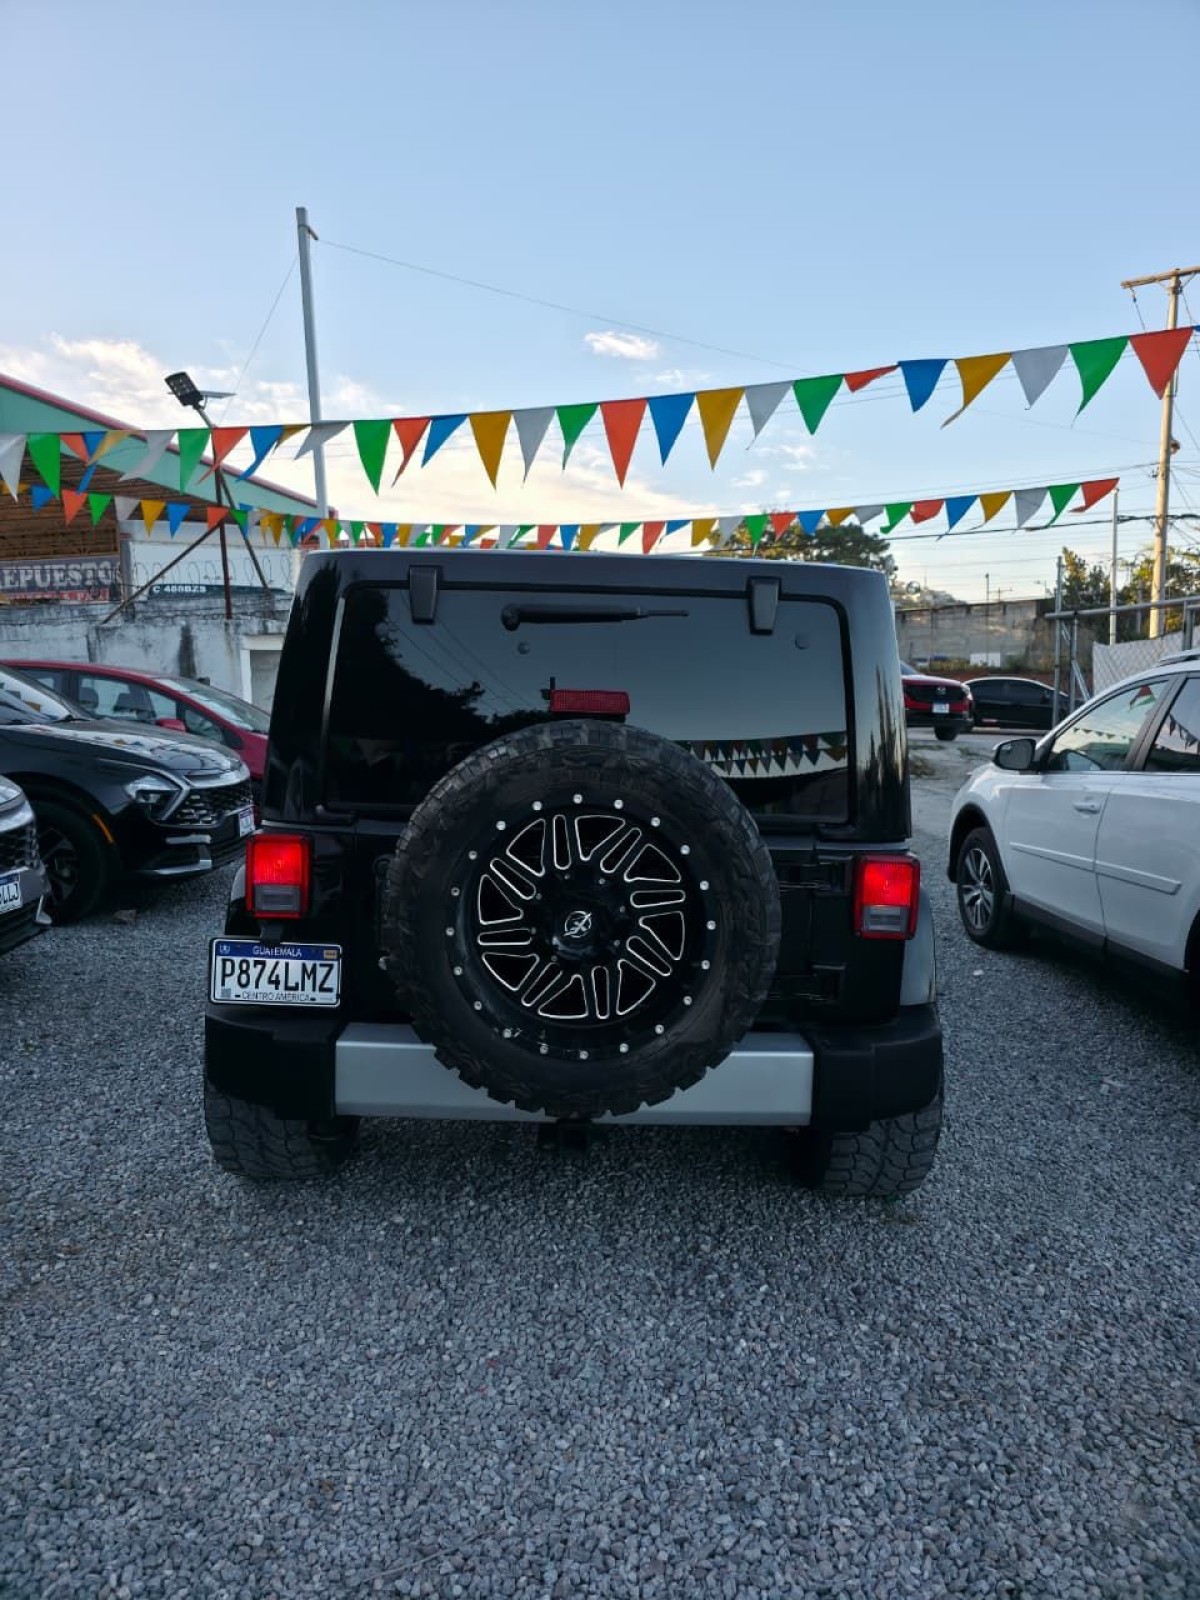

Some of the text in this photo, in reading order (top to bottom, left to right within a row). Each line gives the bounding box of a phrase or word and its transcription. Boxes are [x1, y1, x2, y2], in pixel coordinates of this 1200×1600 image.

[0, 561, 120, 588] EPUESTO
[252, 945, 302, 957] GUATEMALA
[221, 958, 334, 993] P874LMZ
